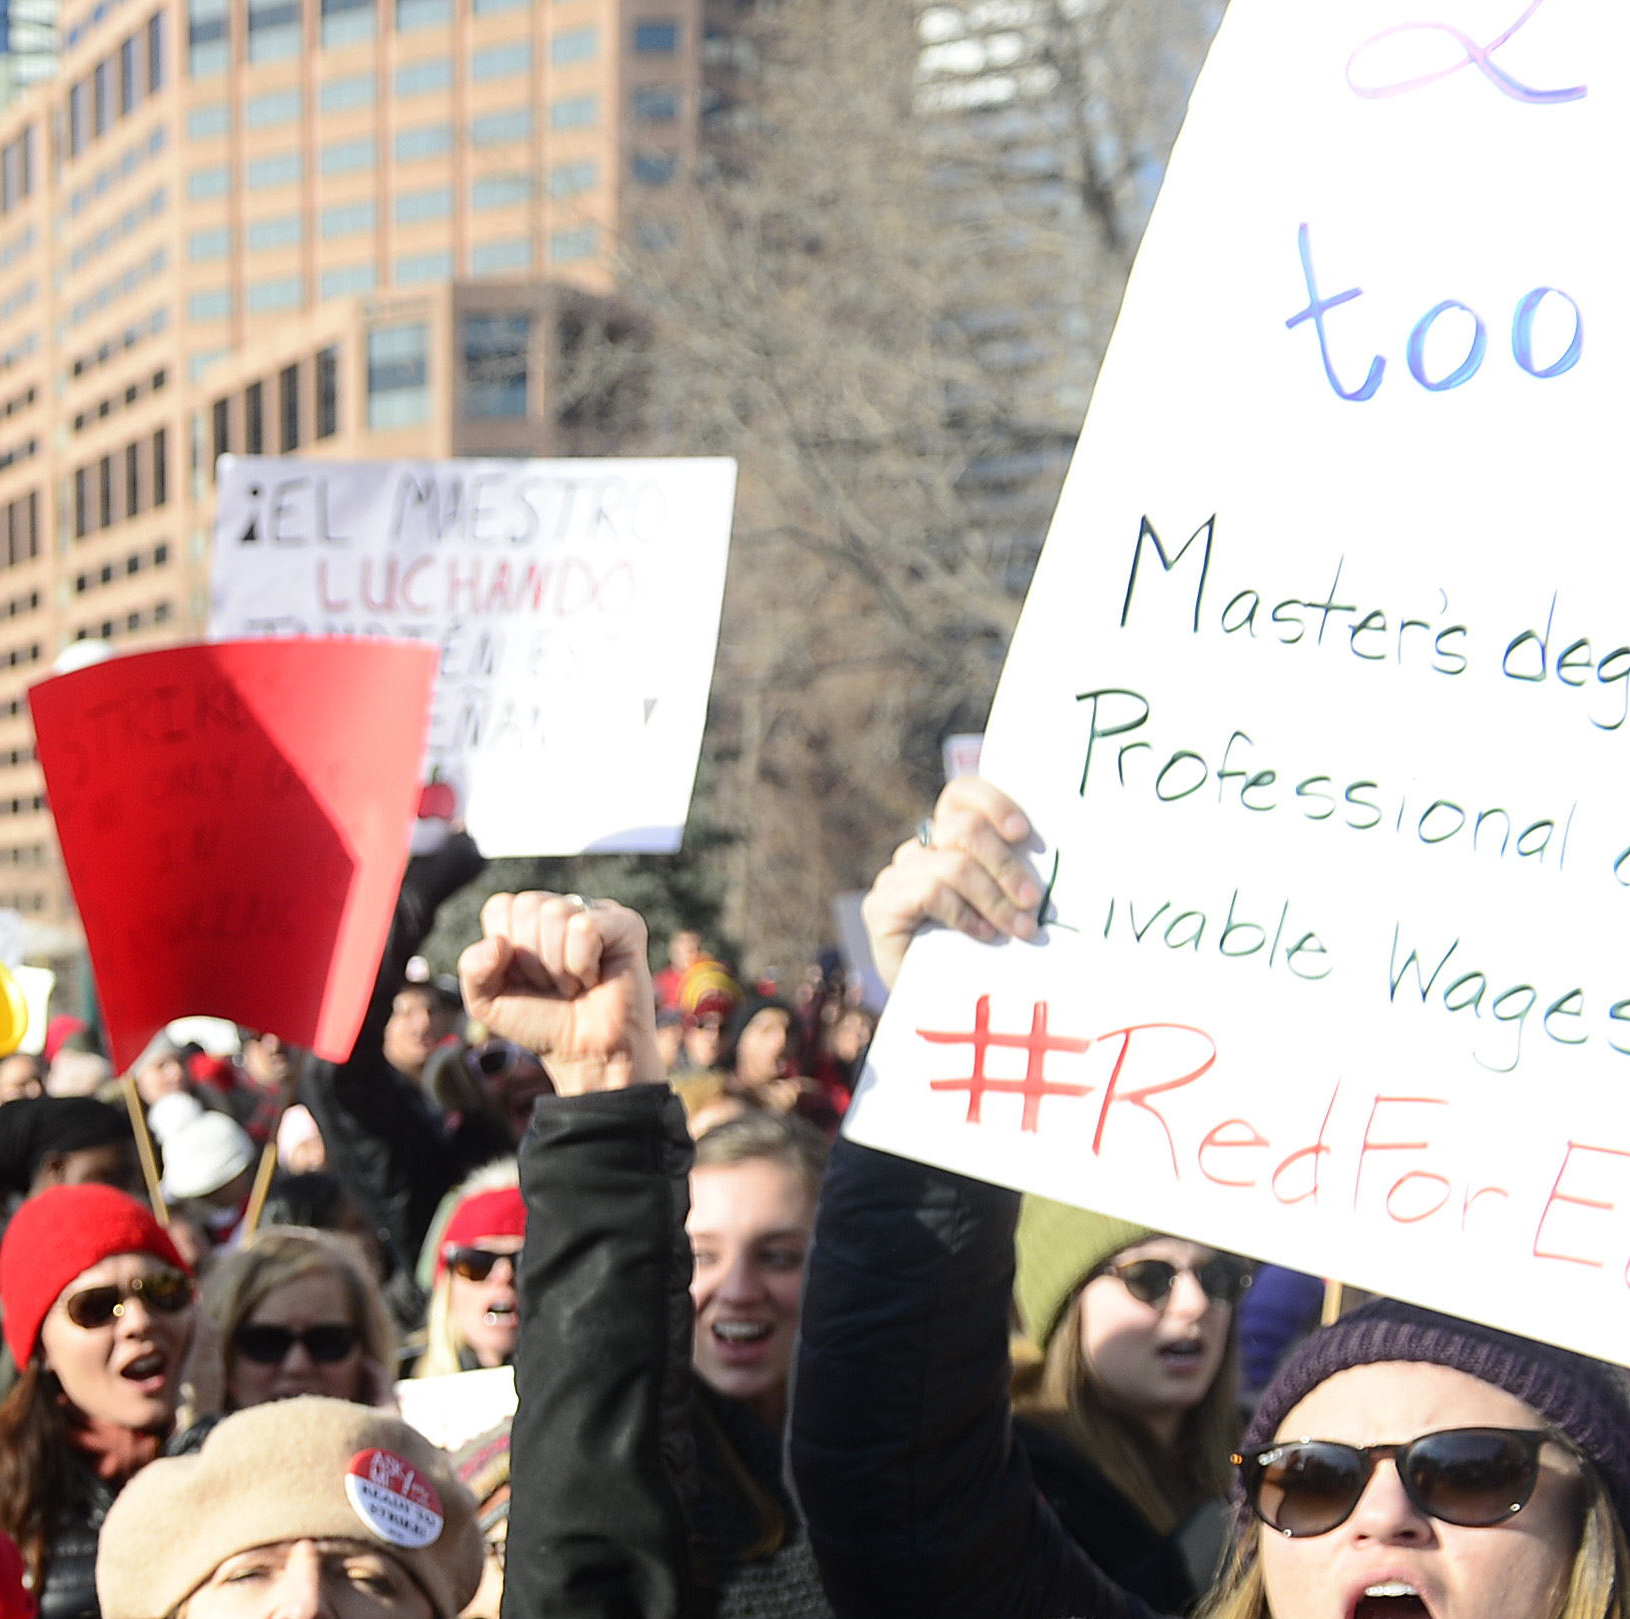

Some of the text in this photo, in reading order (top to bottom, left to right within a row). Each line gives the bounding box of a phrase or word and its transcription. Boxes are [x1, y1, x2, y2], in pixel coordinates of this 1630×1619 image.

[1285, 220, 1585, 402] too
[316, 553, 637, 616] LUCHANDO
[1119, 511, 1469, 675] Master's
[1075, 687, 1577, 872] Professional
[915, 992, 1630, 1289] #RedForE
